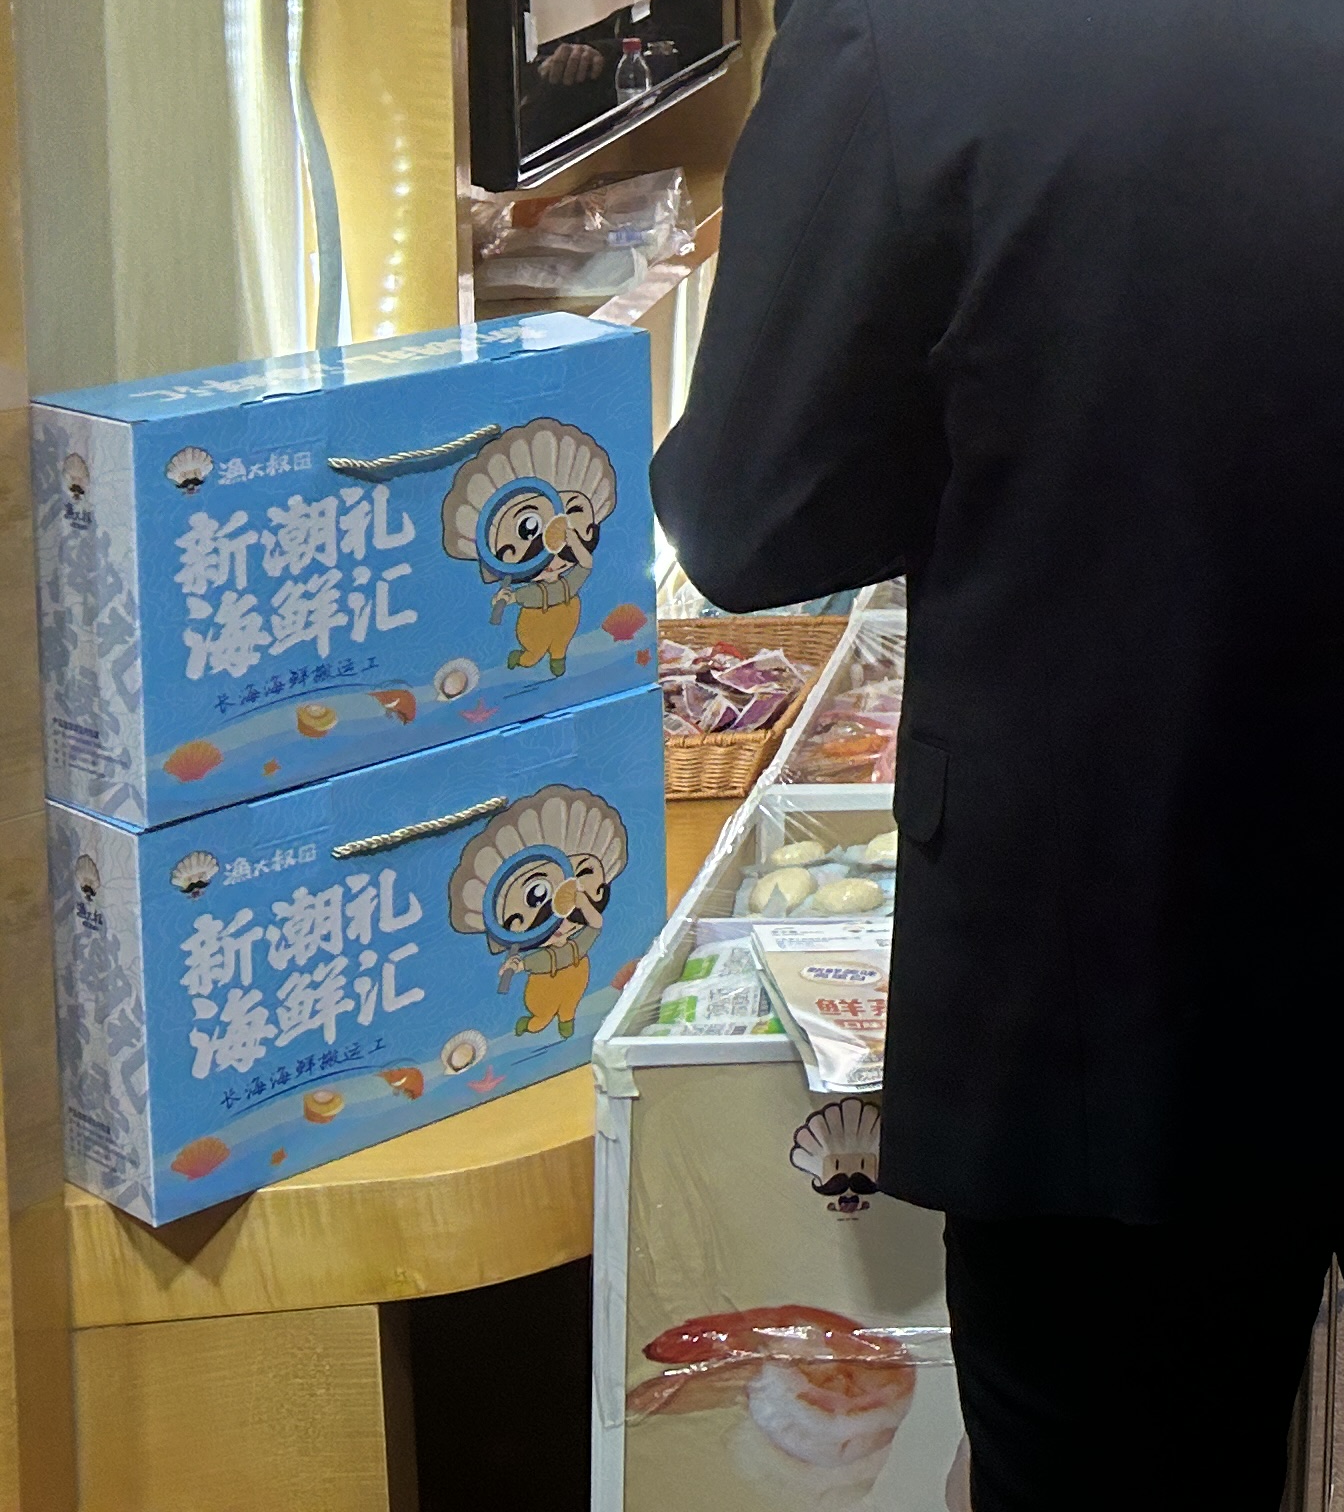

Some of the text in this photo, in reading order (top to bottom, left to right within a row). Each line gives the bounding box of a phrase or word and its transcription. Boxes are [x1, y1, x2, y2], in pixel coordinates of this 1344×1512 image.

[176, 485, 413, 594] 新潮礼
[185, 565, 417, 680] 海鲜汇
[214, 656, 379, 713] 长海海鲜搬运工
[179, 868, 422, 996] 新潮礼
[188, 943, 424, 1078] 海鲜汇
[220, 1038, 387, 1109] 长海海鲜搬运工
